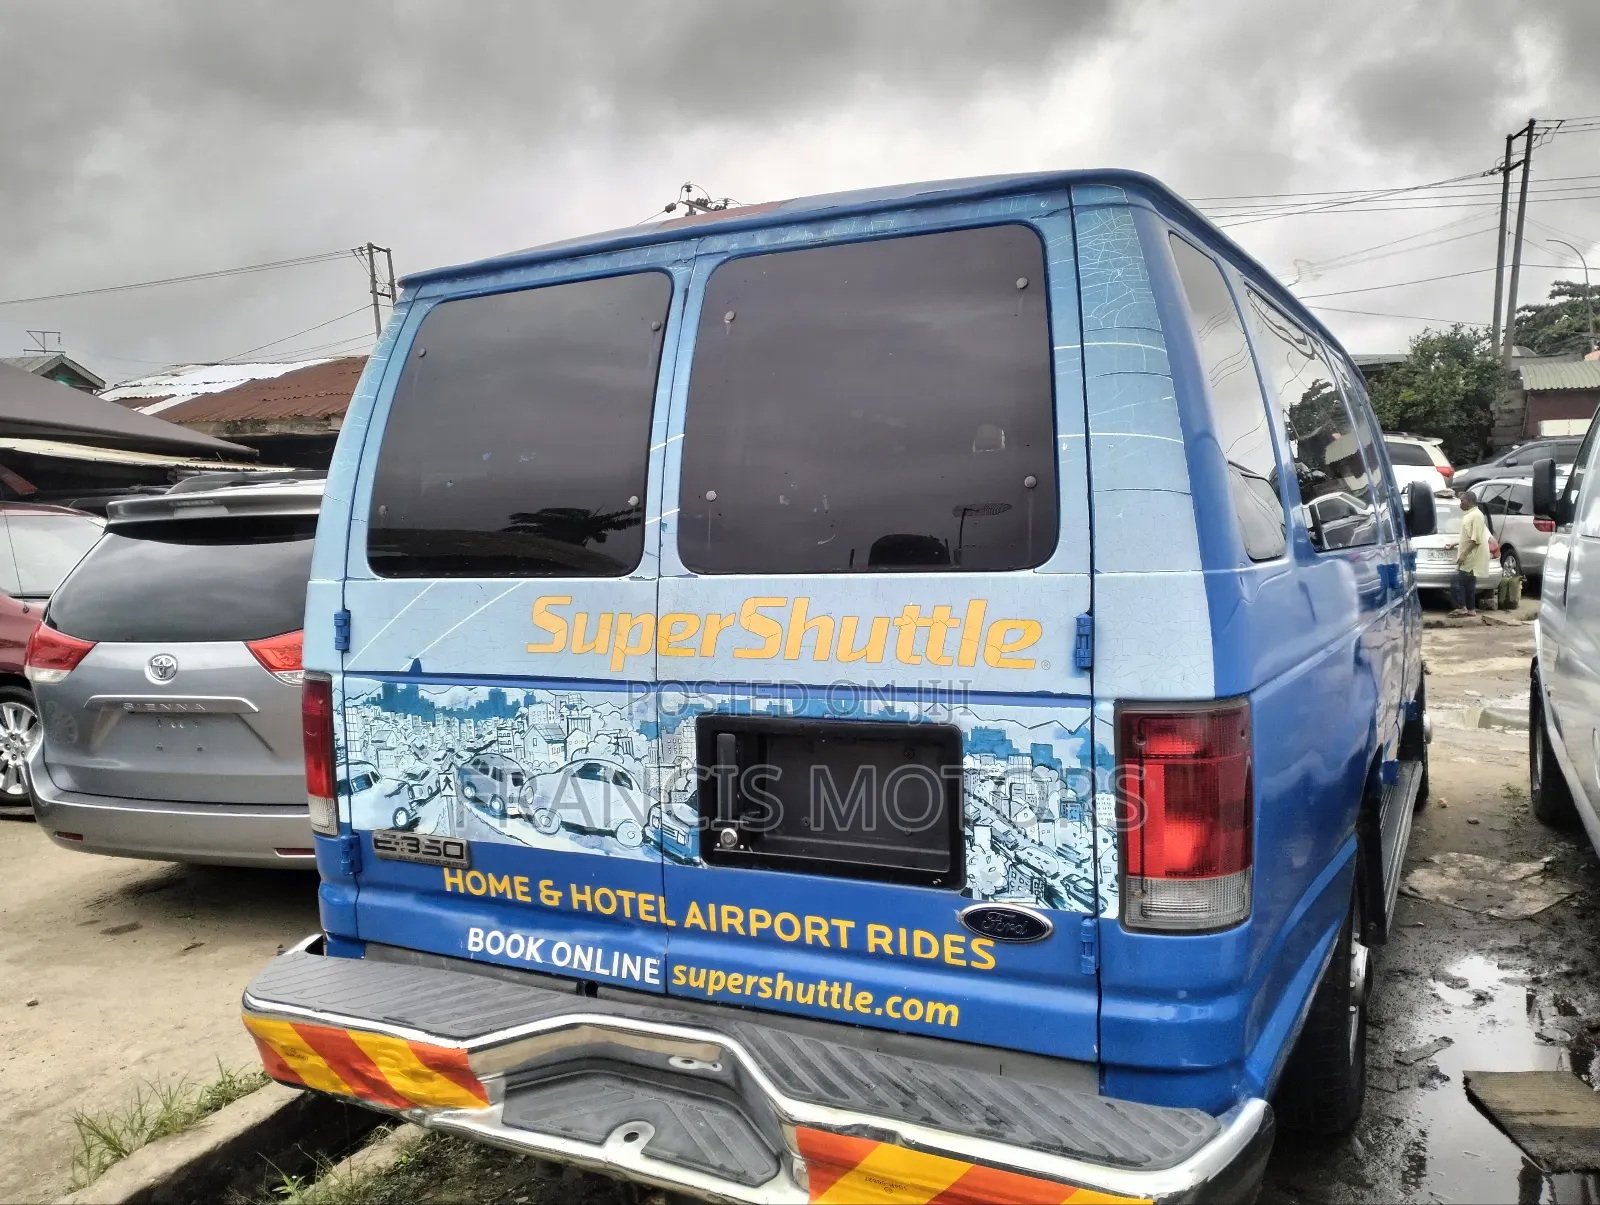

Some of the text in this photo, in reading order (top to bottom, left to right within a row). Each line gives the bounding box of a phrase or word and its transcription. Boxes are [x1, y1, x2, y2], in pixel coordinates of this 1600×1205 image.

[527, 595, 1043, 671] SuperShuttle
[123, 702, 206, 711] SIENNA
[374, 833, 464, 859] E-350
[443, 867, 996, 969] HOME & HOTEL AIRPORT RIDES
[981, 911, 1029, 935] Ford
[466, 926, 959, 1027] BOOK ONLINE supershuttle.com
